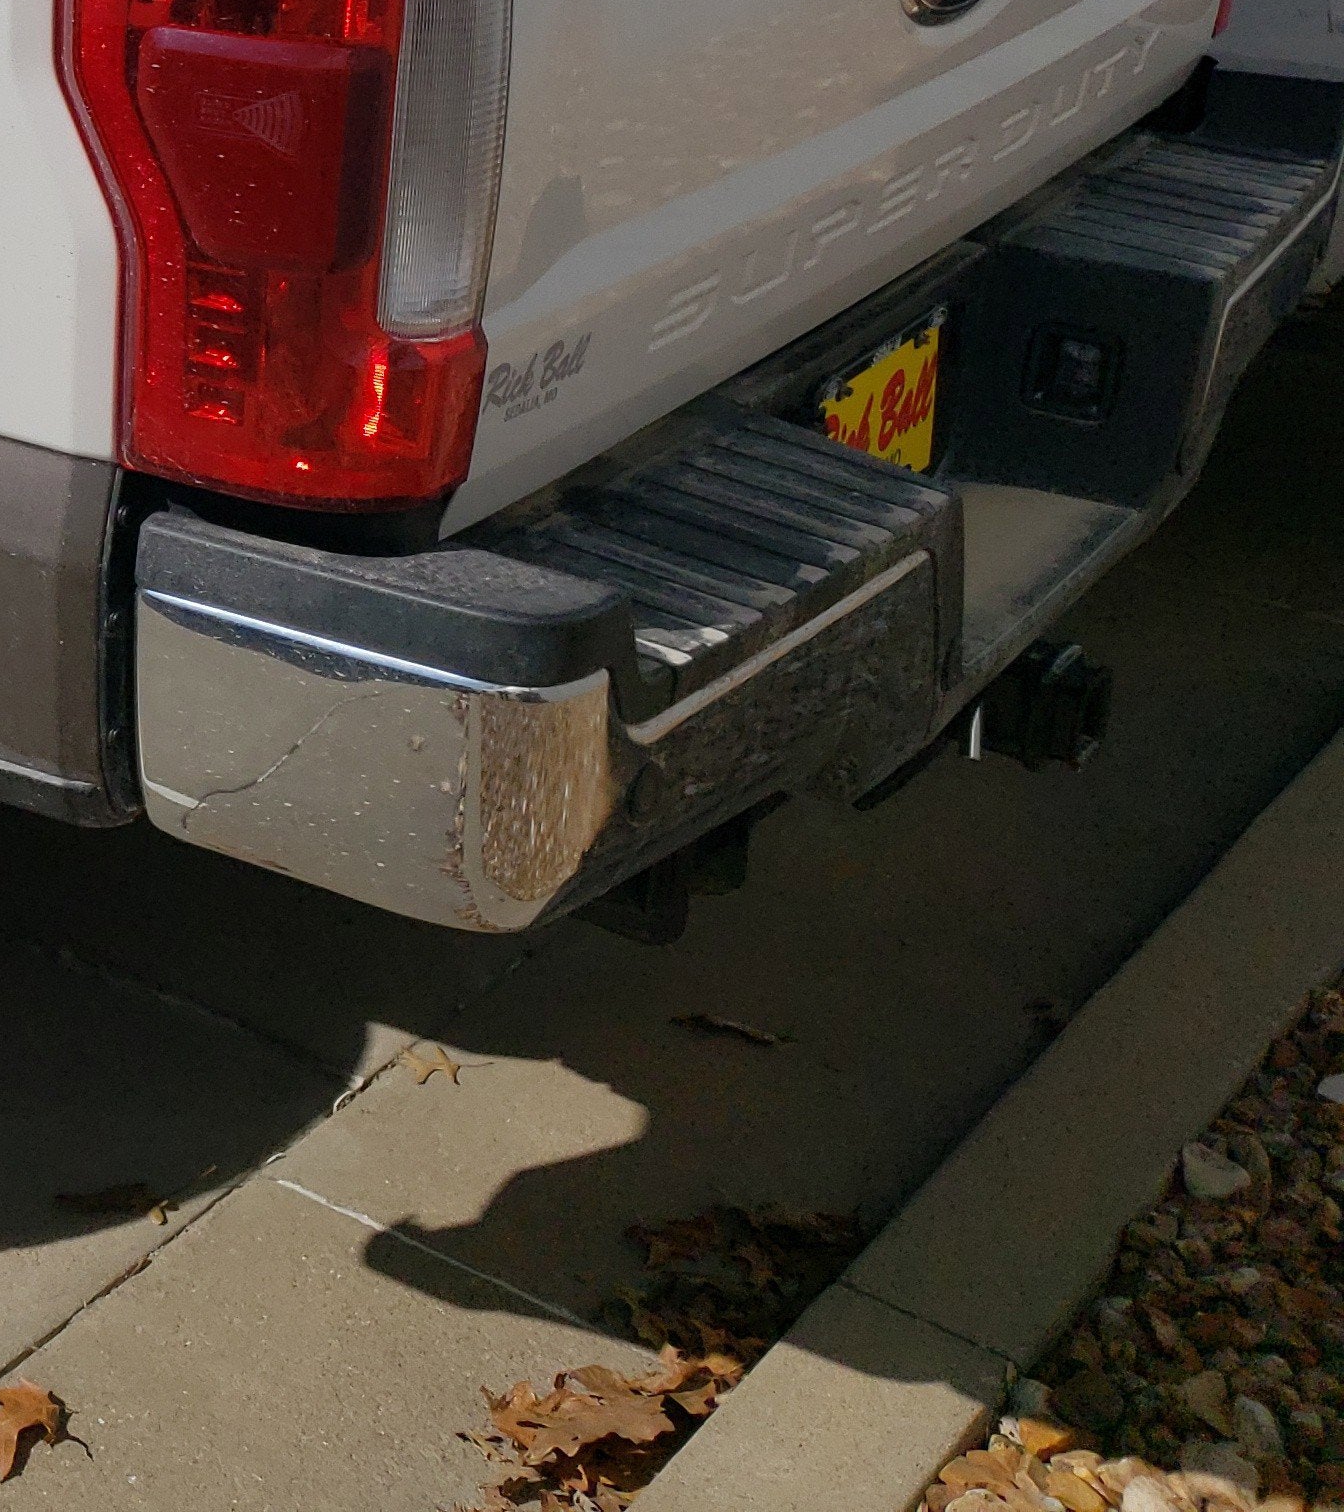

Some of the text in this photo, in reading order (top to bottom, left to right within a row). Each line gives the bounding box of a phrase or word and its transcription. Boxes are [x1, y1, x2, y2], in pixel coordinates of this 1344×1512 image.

[648, 24, 1163, 354] SUPER DUTY
[482, 331, 593, 416] Rick Ball
[877, 351, 938, 452] Ball
